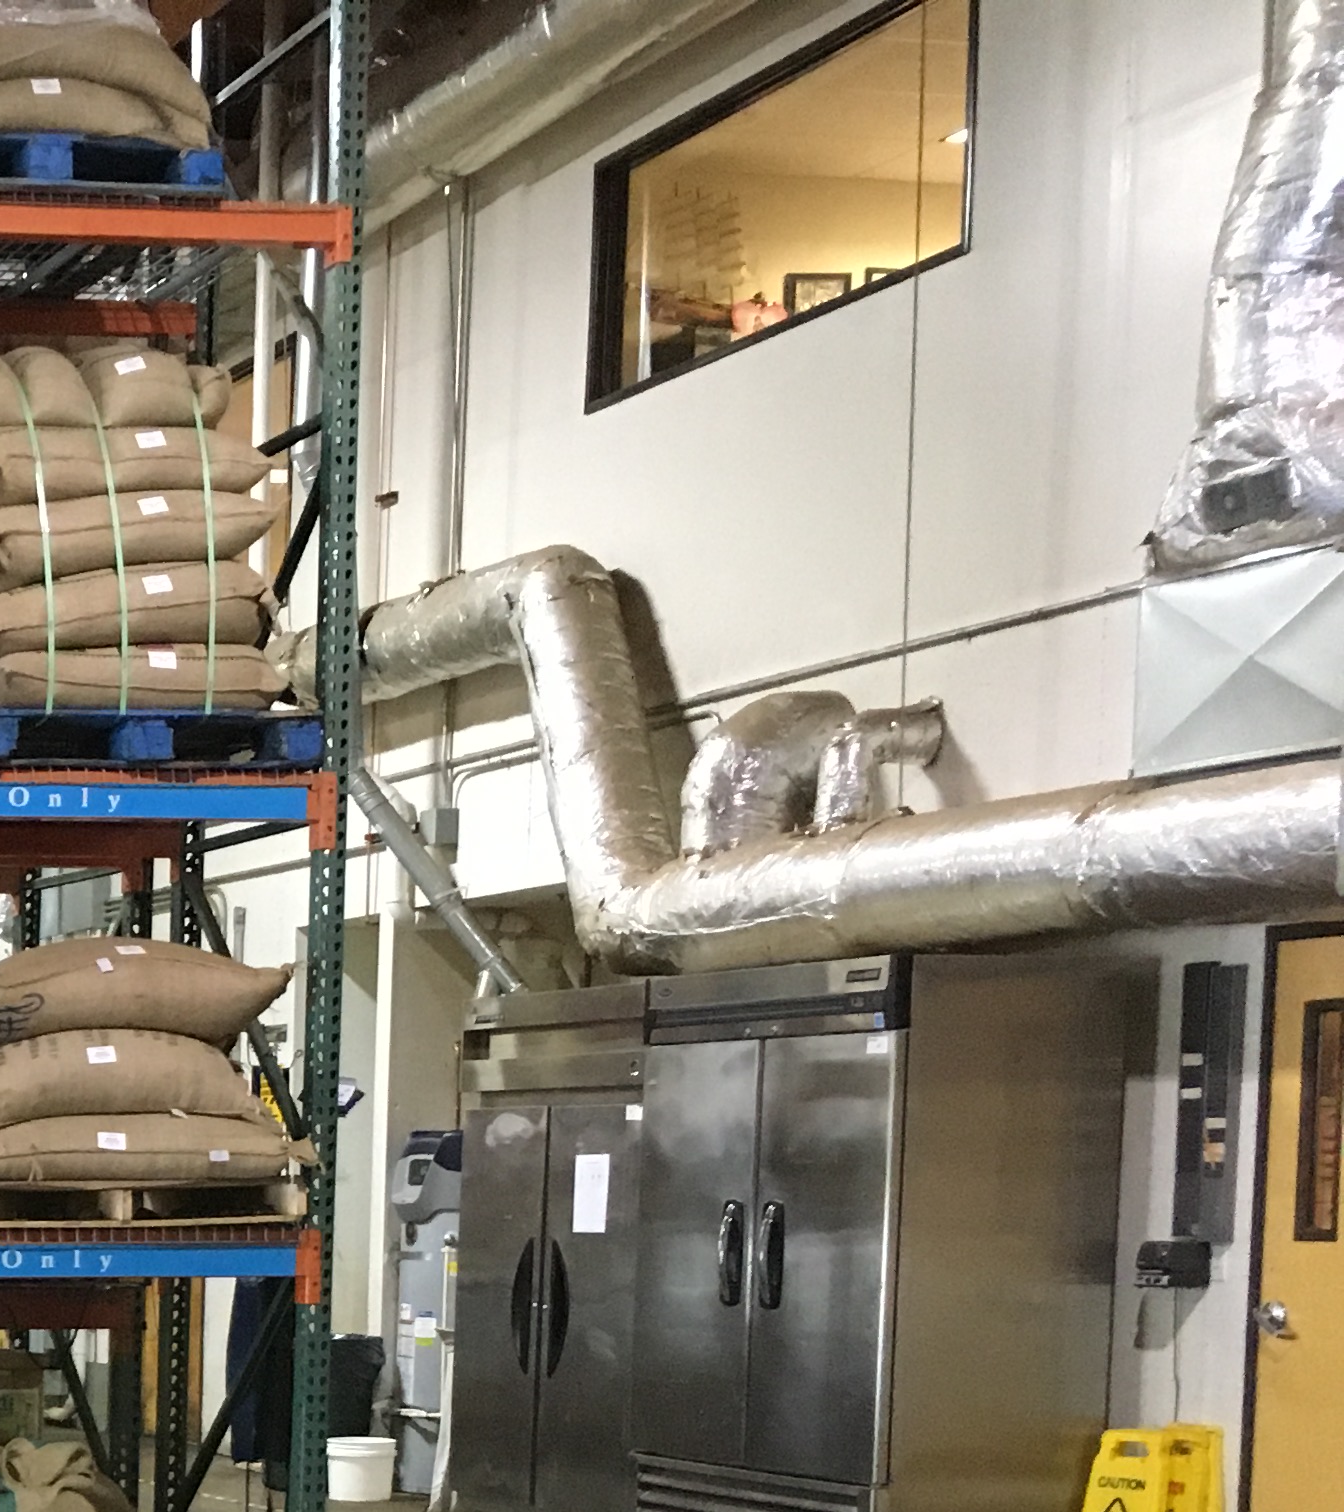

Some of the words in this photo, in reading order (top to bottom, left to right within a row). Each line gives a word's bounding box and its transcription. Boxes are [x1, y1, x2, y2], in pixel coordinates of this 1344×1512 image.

[7, 785, 121, 812] Only
[0, 1249, 113, 1273] Only
[1098, 1476, 1146, 1490] CAUTION
